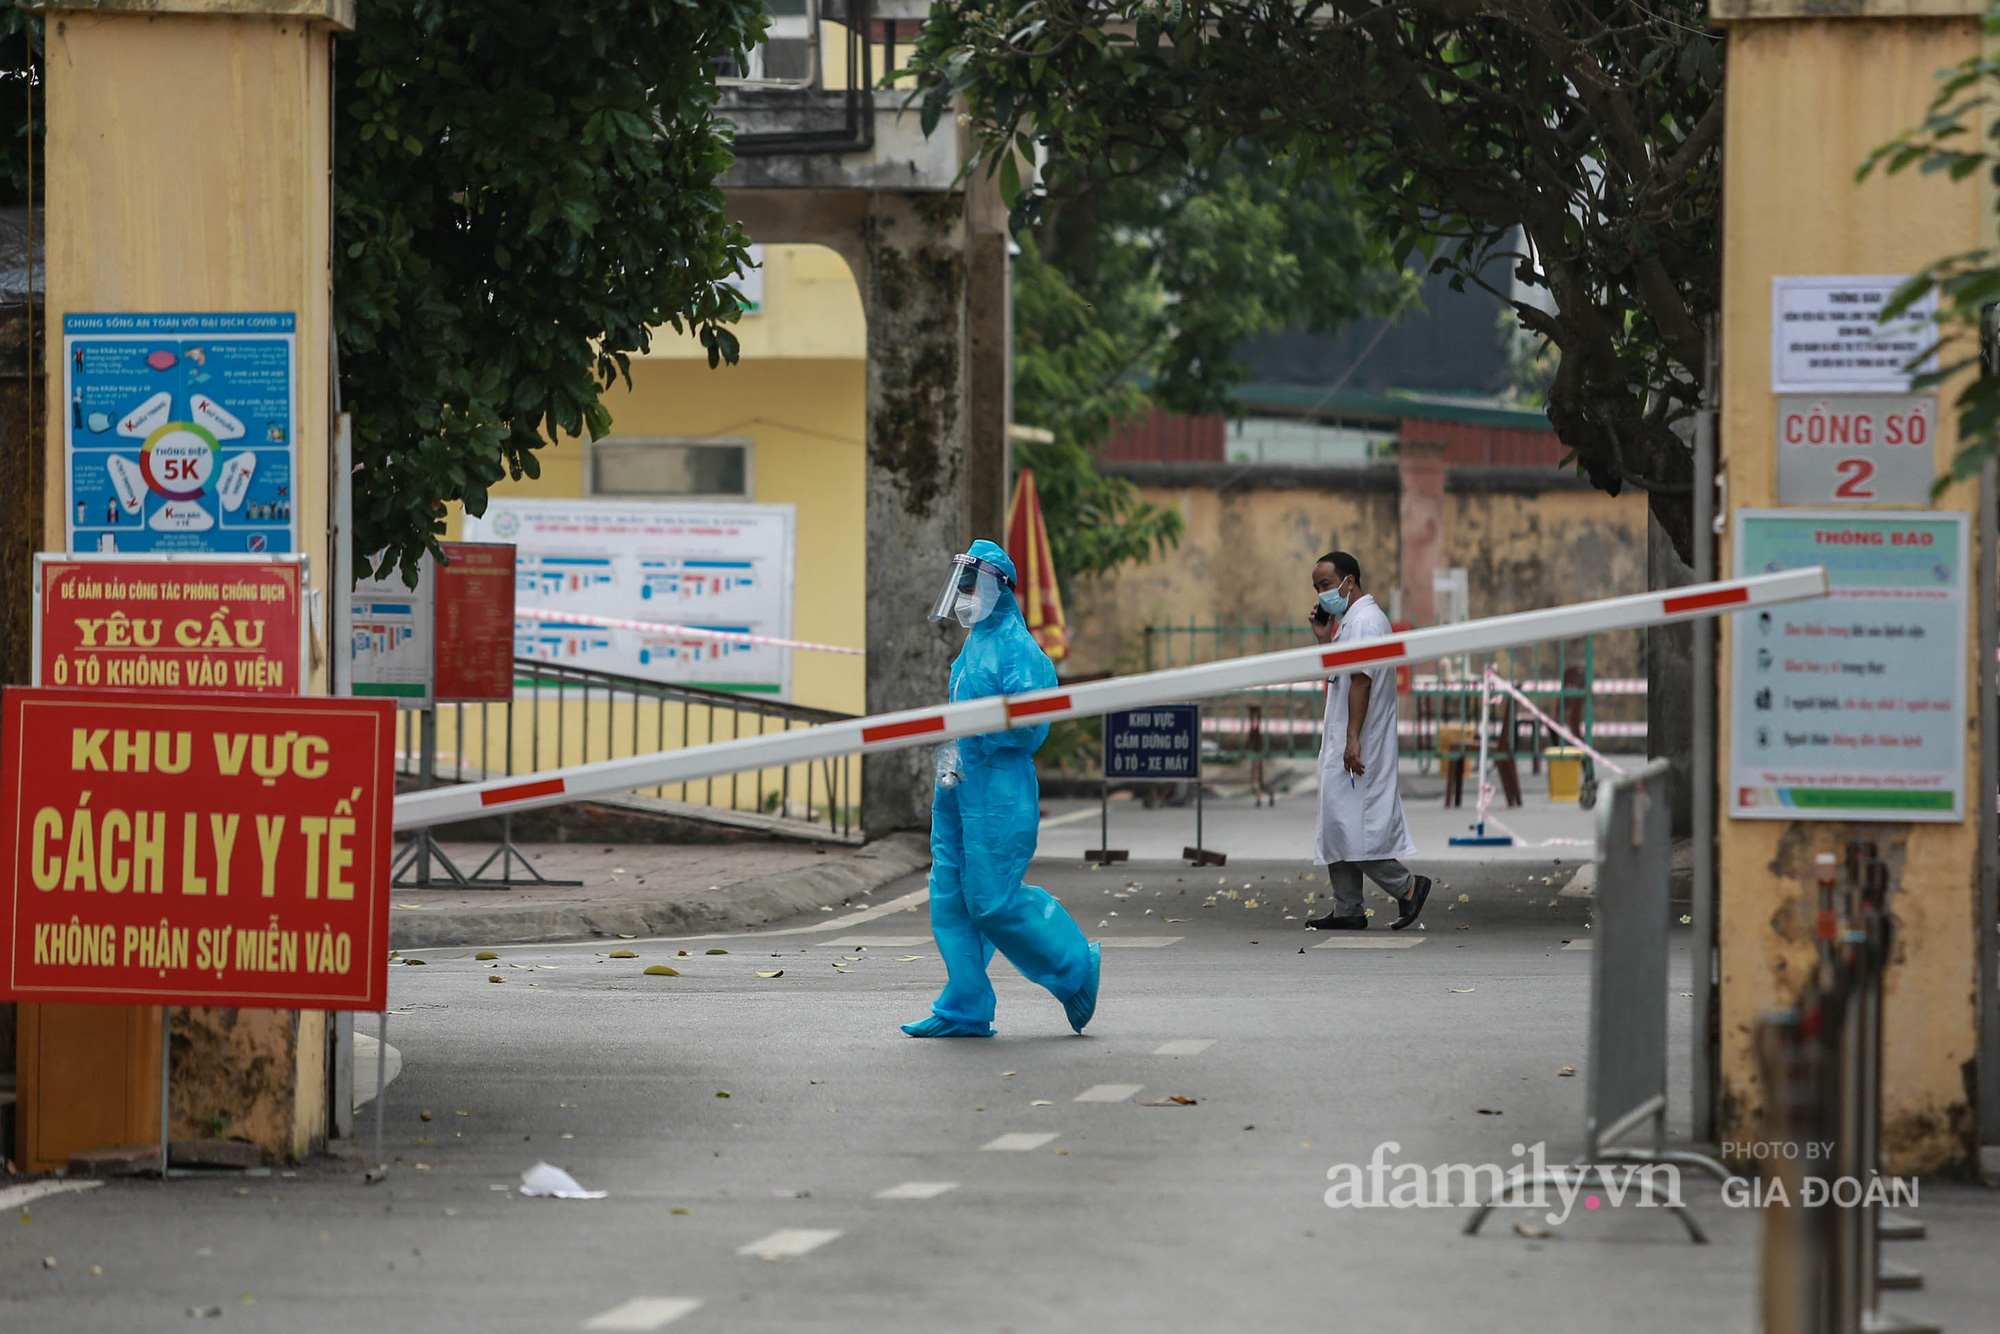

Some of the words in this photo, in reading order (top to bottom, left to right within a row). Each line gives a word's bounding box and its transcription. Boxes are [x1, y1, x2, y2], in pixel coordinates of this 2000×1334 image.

[67, 318, 104, 329] CHUNG
[105, 316, 134, 328] SỐNG
[136, 318, 150, 328] AN
[153, 316, 180, 328] TOÀN
[181, 316, 199, 328] VỚI
[1785, 400, 1873, 445] CỔNG
[1885, 402, 1928, 445] SỐ
[155, 446, 186, 457] THÔNG
[187, 446, 208, 457] ĐIỆP
[164, 458, 199, 480] 5K
[1835, 458, 1875, 498] 2
[1814, 529, 1884, 546] THÔNG
[1890, 528, 1934, 547] BÁO
[61, 576, 76, 600] ĐỂ
[78, 576, 102, 600] ĐẢM
[105, 576, 126, 601] BẢO
[129, 580, 158, 601] CÔNG
[160, 579, 181, 601] TÁC
[183, 579, 220, 602] PHÒNG
[222, 577, 258, 602] CHỐNG
[260, 583, 285, 605] DỊCH
[75, 609, 163, 647] YÊU
[174, 605, 265, 647] CẦU
[54, 653, 68, 685] Ô
[75, 654, 101, 686] TÔ
[107, 653, 180, 686] KHÔNG
[186, 654, 228, 686] VÀO
[235, 655, 283, 692] VIỆN
[1129, 712, 1151, 727] KHU
[1153, 711, 1175, 730] VỰC
[1114, 730, 1139, 749] CẤM
[1142, 731, 1172, 749] DỪNG
[1174, 729, 1189, 749] ĐỖ
[71, 727, 192, 774] KHU
[213, 730, 330, 787] VỰC
[1114, 753, 1122, 770] Ô
[1125, 753, 1138, 770] TÔ
[1148, 756, 1162, 770] XE
[1165, 753, 1189, 770] MÁY
[31, 790, 166, 895] CÁCH
[182, 811, 240, 896] LY
[255, 814, 286, 898] Y
[300, 786, 363, 901] TẾ
[34, 914, 115, 966] KHÔNG
[124, 917, 189, 977] PHẬN
[196, 924, 232, 979] SỰ
[235, 914, 298, 972] MIỄN
[305, 922, 352, 975] VÀO
